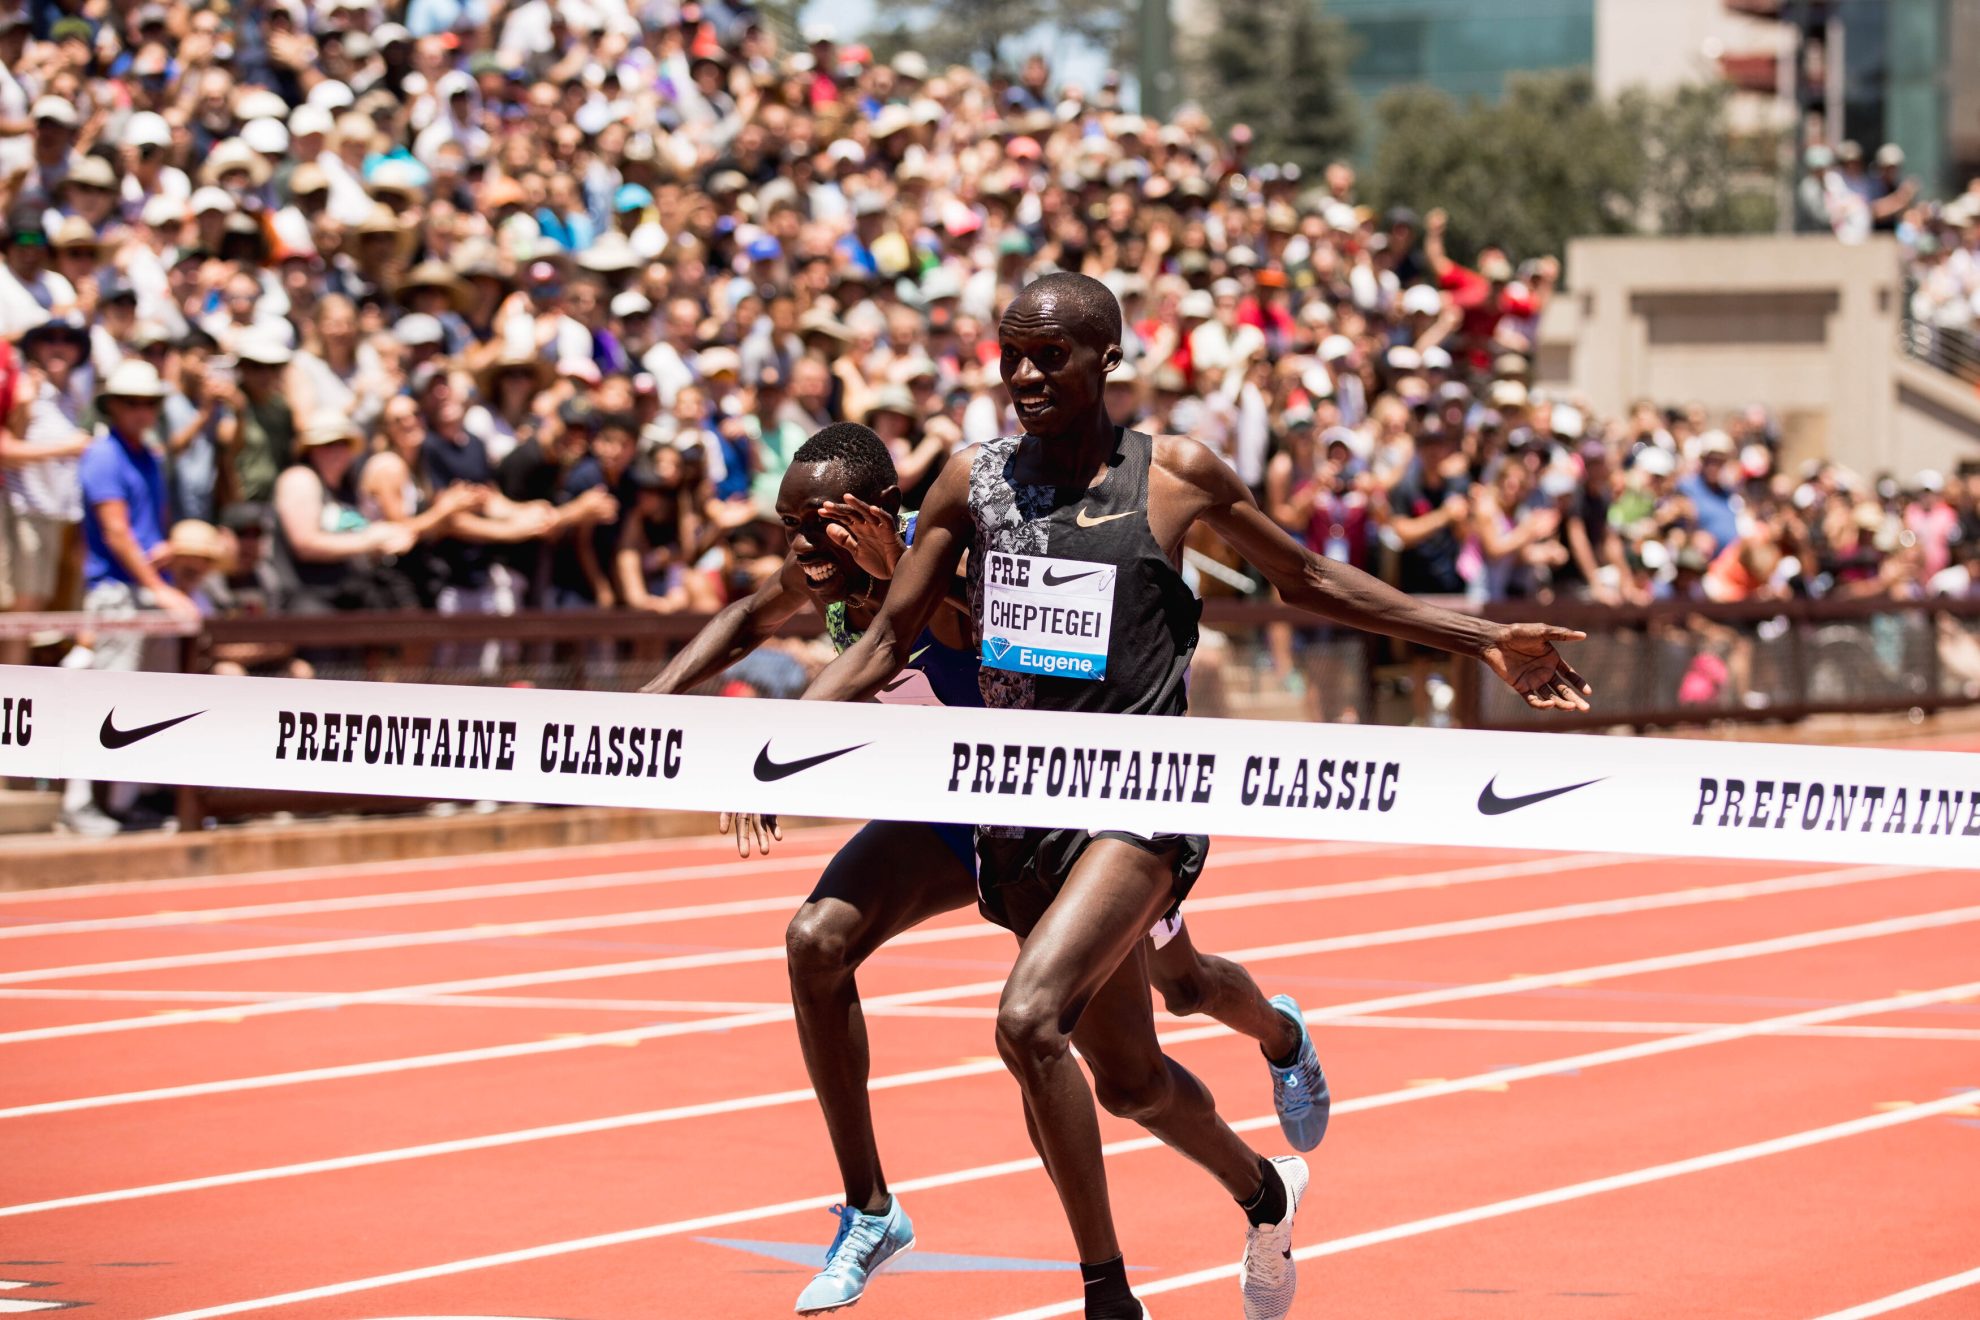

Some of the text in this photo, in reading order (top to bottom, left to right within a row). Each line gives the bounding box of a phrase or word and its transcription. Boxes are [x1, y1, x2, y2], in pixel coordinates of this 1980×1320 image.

[991, 555, 1031, 588] PRE
[990, 599, 1102, 638] CHEPTEGEI
[1019, 648, 1093, 672] Eugene
[1, 697, 33, 747] IC
[275, 710, 684, 780] PREFONTAINE CLASSIC
[947, 742, 1400, 813] PREFONTAINE CLASSIC
[1692, 777, 1980, 836] PREFONTAINE
